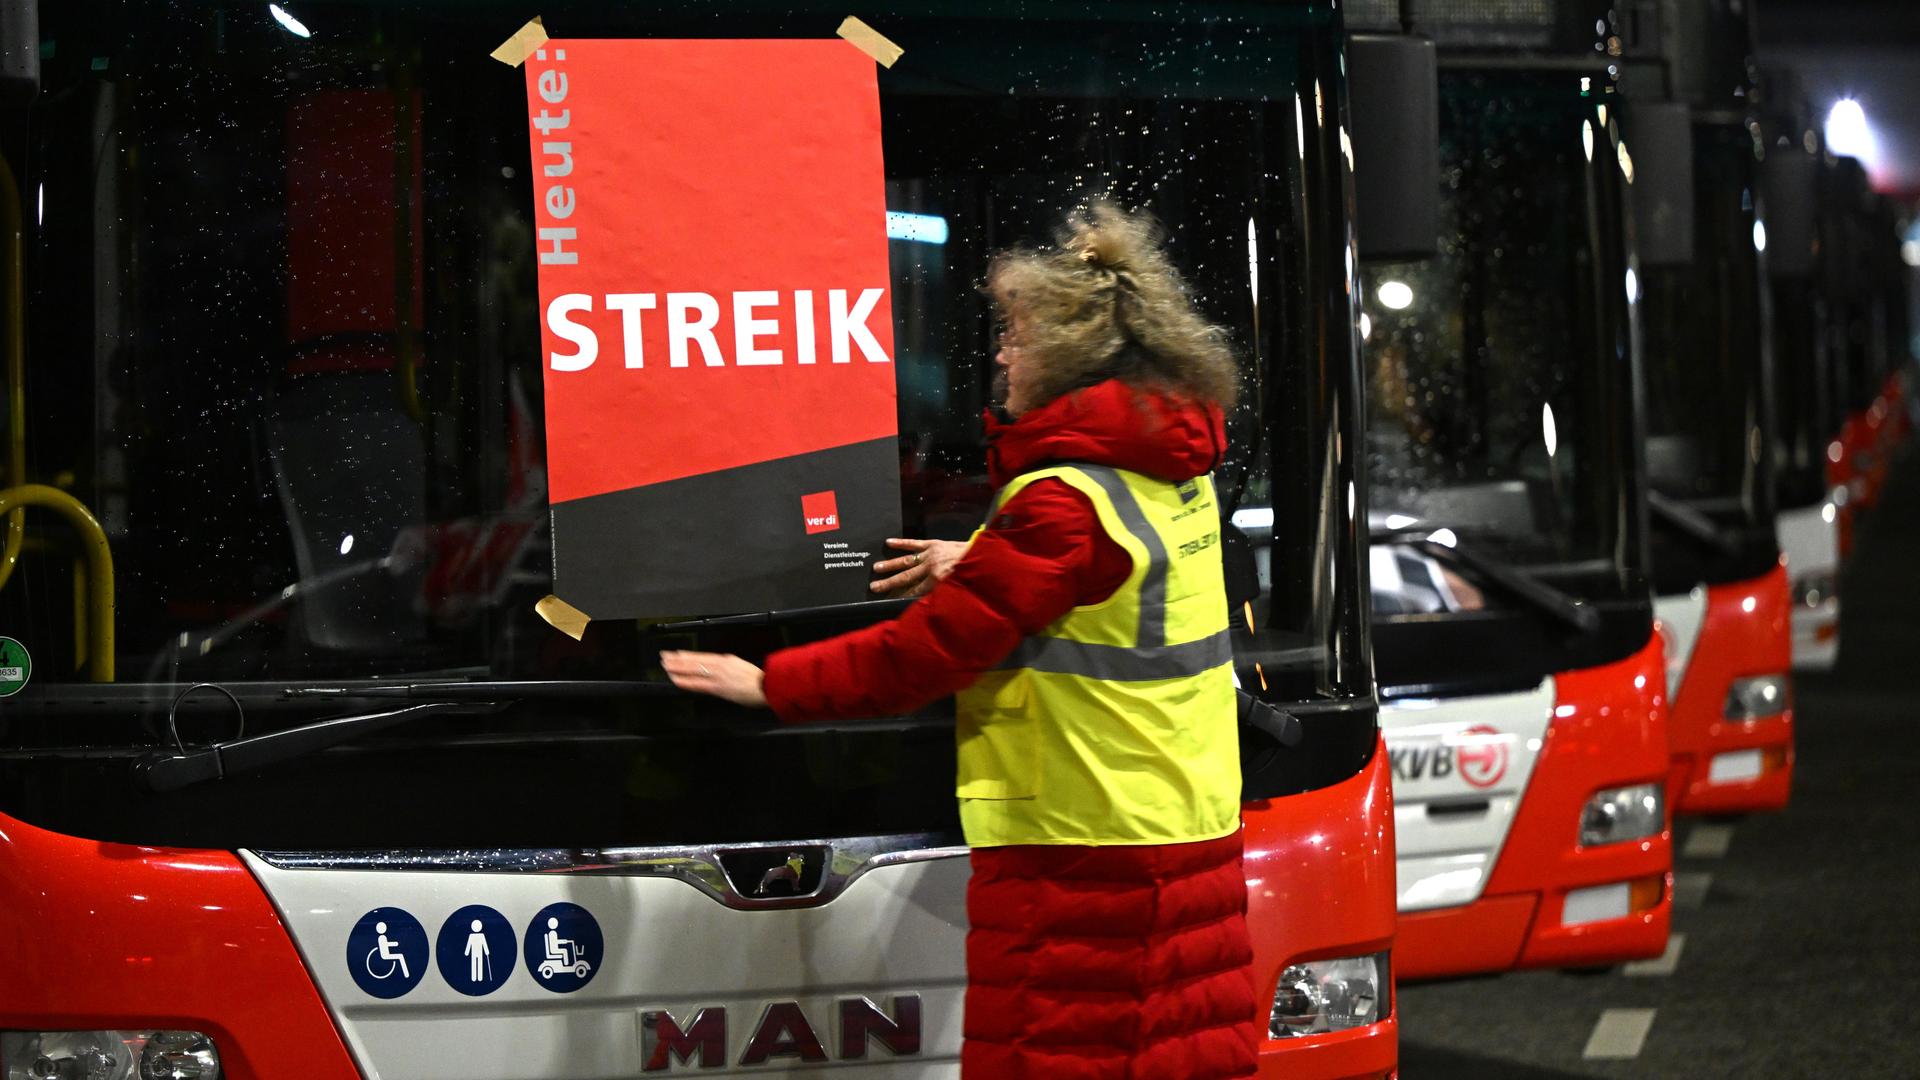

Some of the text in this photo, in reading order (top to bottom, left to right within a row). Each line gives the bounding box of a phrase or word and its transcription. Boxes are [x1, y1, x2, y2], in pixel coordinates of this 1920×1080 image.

[532, 48, 579, 266] Heute:
[546, 287, 891, 373] STREIK
[823, 551, 871, 559] Dienstleistungs-
[824, 560, 864, 569] gewerkschaft
[1389, 744, 1453, 781] KVB
[639, 992, 921, 1072] MAN
